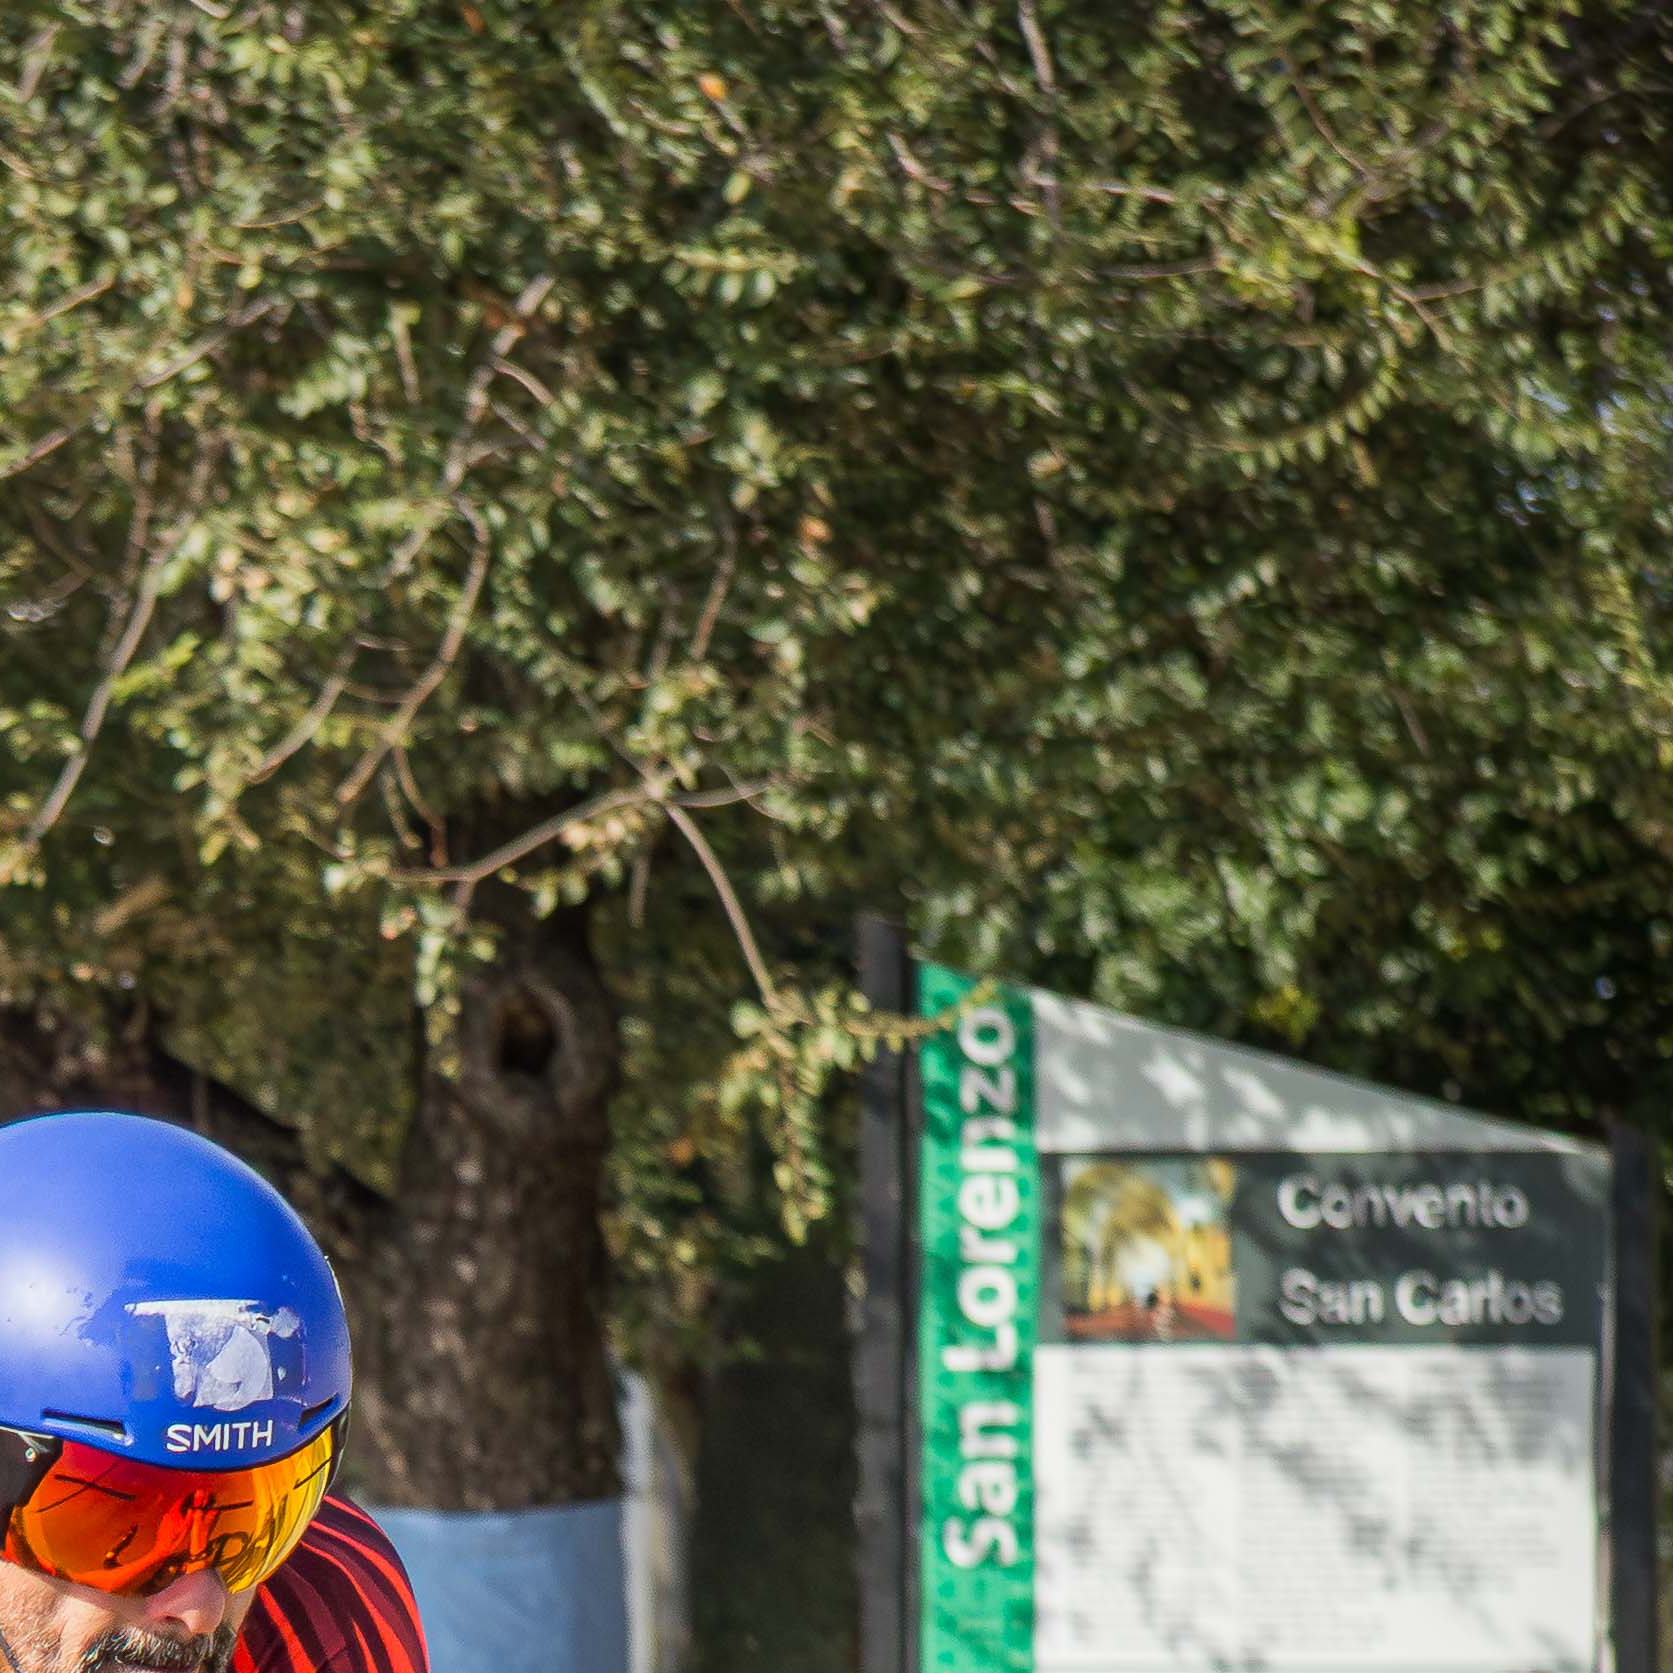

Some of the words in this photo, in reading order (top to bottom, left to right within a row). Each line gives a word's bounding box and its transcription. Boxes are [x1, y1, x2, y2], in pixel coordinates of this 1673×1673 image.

[941, 1004, 1020, 1374] Lorenzo
[1278, 1173, 1530, 1230] Convento
[1280, 1267, 1385, 1326] San
[1394, 1267, 1565, 1326] Carlos
[166, 1419, 273, 1452] SMITH
[942, 1399, 1020, 1568] San
